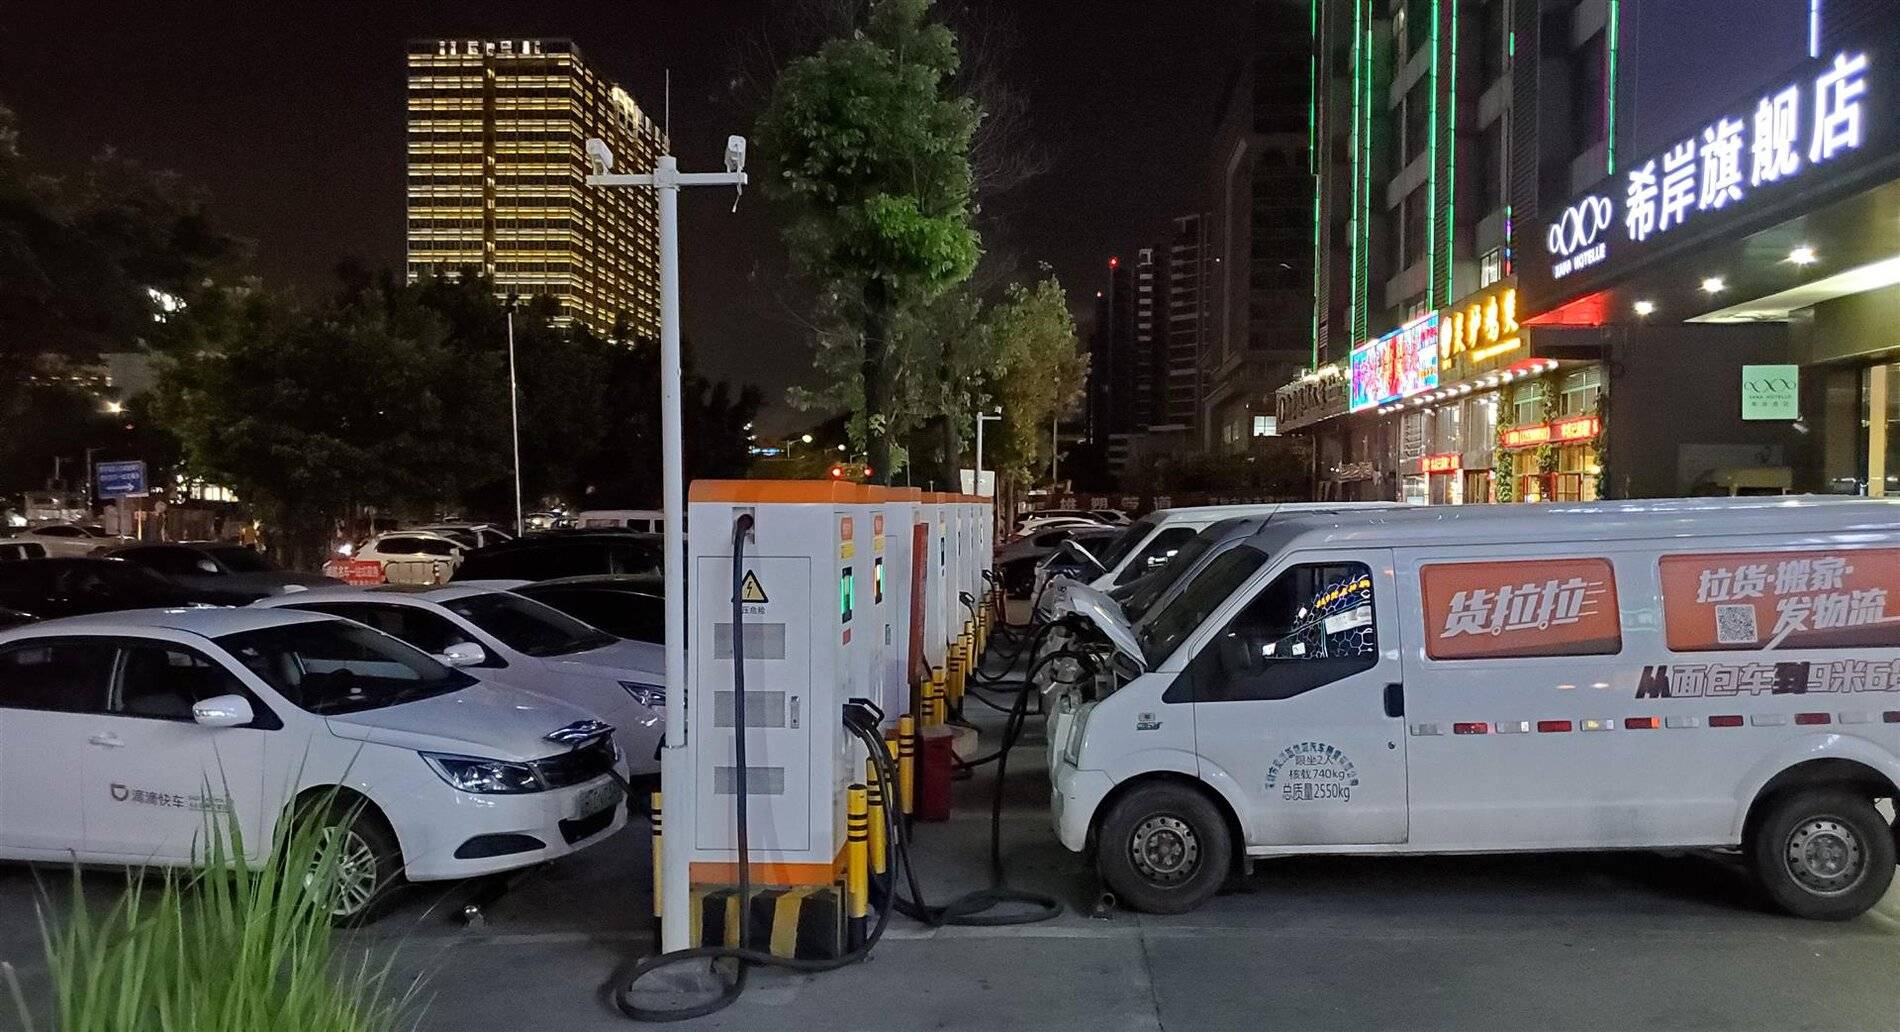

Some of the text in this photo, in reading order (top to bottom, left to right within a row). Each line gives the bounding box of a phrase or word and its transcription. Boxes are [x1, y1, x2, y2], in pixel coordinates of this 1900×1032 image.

[1625, 53, 1868, 241] 希岸旗舰店
[1440, 577, 1588, 638] 货拉拉
[1771, 588, 1887, 635] 发物流
[1283, 782, 1350, 802] 总质量2550kg
